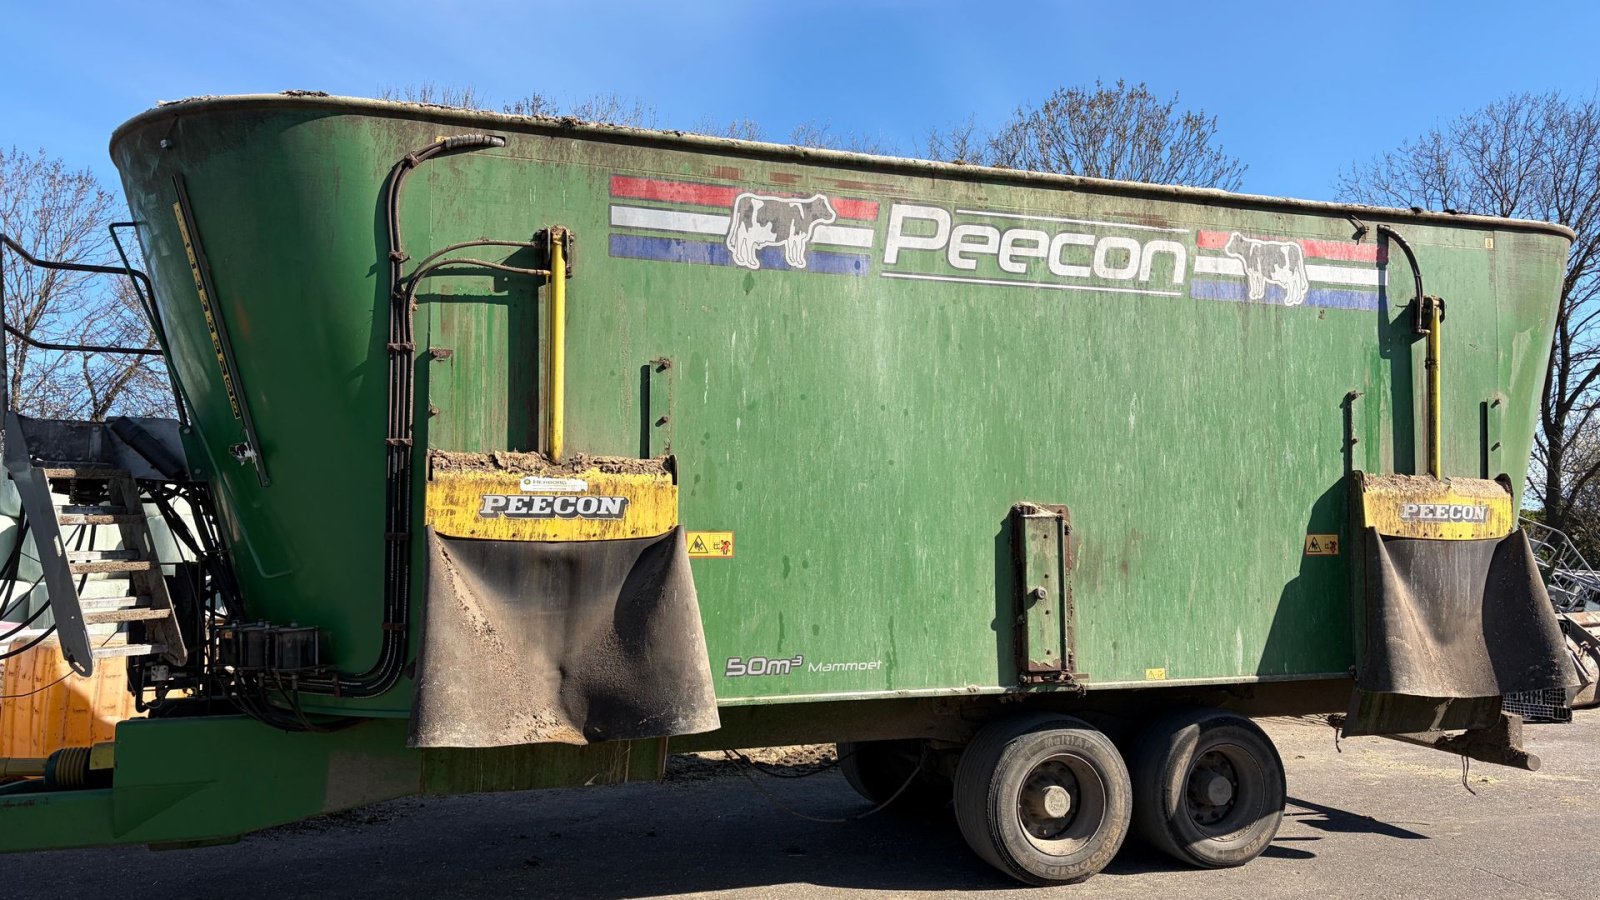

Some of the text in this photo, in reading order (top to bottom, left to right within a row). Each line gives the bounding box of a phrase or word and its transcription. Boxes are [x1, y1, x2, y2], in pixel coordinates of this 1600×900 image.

[883, 203, 1187, 284] Peecon
[480, 495, 629, 519] PEECON
[1401, 503, 1488, 523] PEECON
[807, 659, 883, 673] Mammoet
